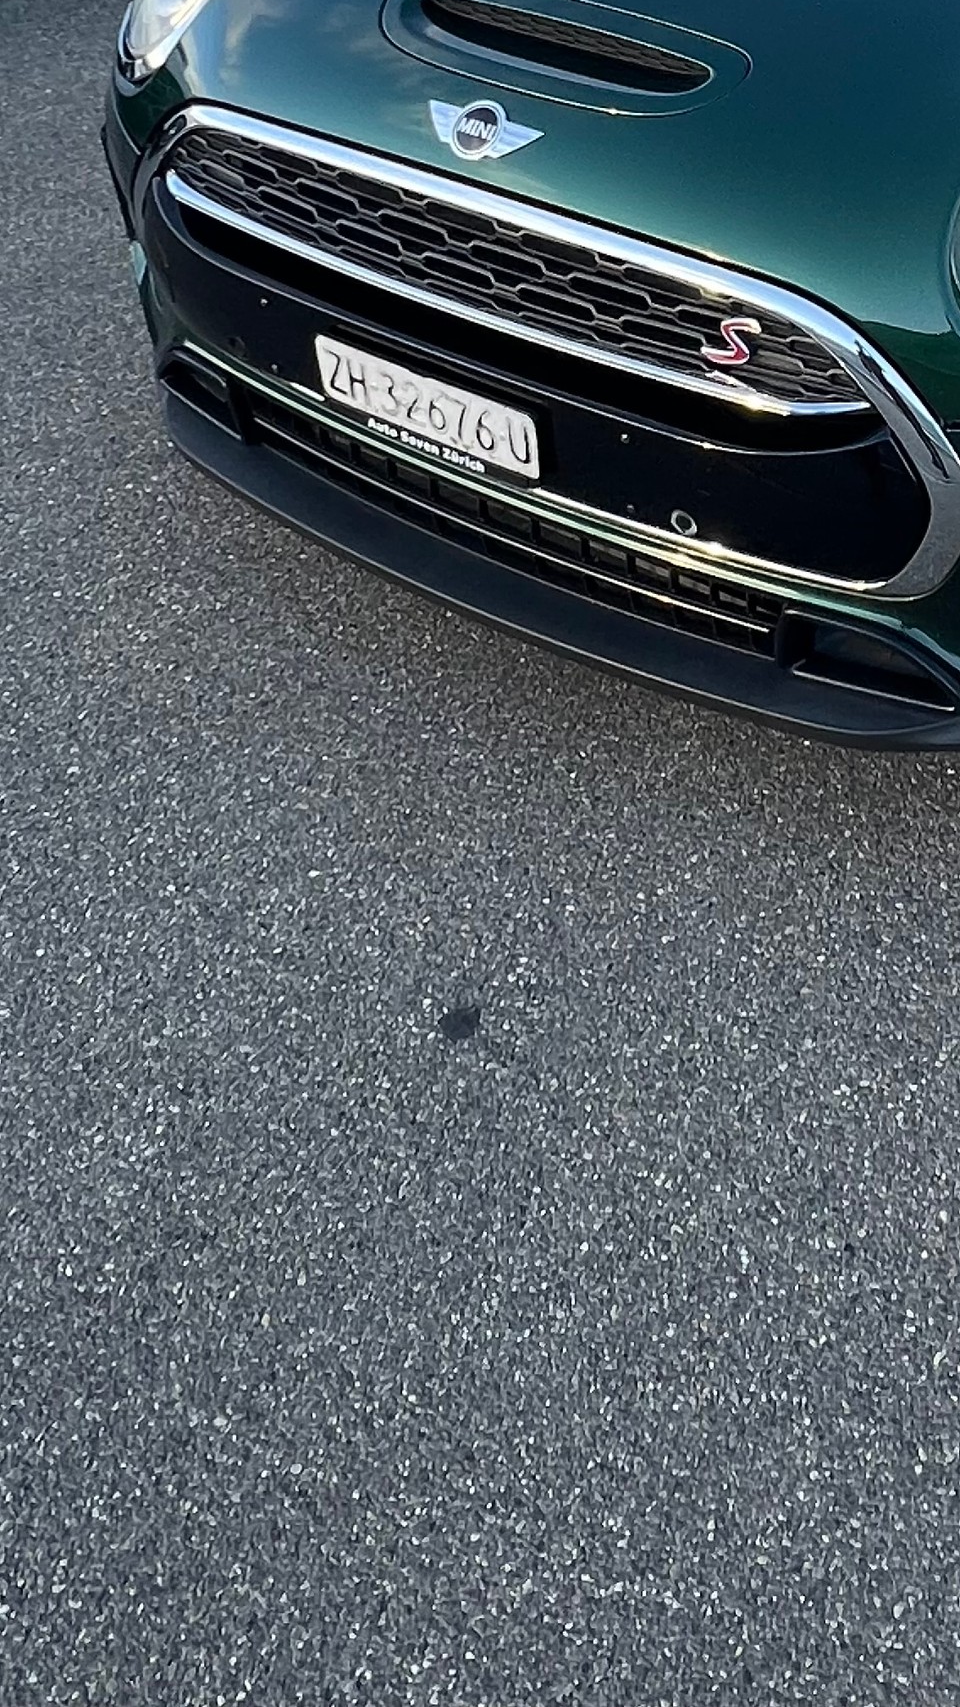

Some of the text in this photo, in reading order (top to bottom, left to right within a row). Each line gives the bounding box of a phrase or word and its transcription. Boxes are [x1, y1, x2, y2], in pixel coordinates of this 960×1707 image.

[457, 117, 498, 141] MINI
[700, 317, 762, 365] S
[367, 417, 486, 474] Auto Seven Zürich
